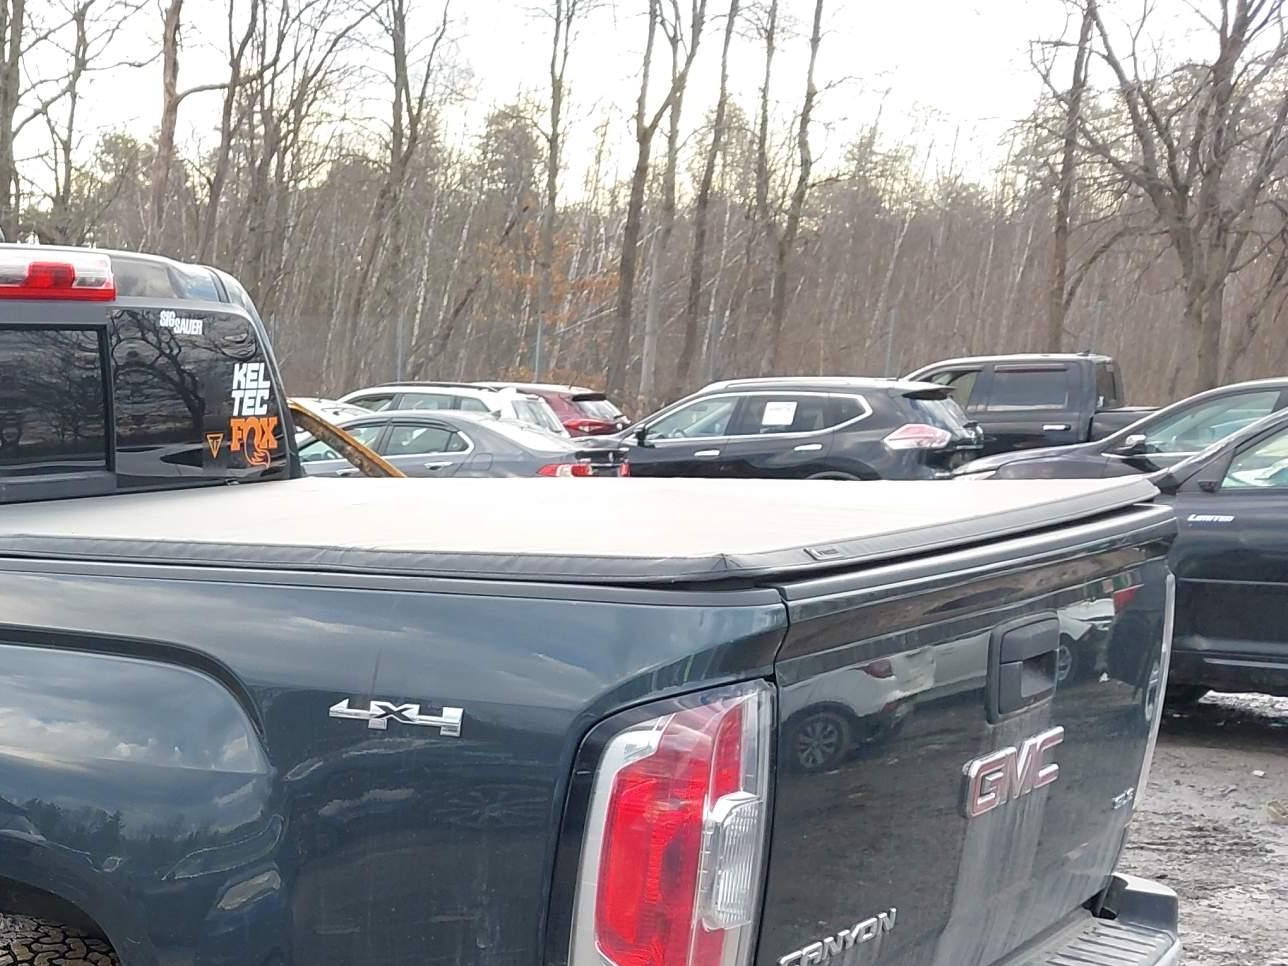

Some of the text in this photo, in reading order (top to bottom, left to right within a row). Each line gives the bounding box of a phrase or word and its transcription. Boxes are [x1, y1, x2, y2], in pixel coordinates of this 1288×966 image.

[174, 318, 203, 335] SAUER
[233, 363, 270, 389] KEL
[232, 389, 269, 416] TEC
[230, 416, 277, 468] FOX
[965, 725, 1065, 818] GMC
